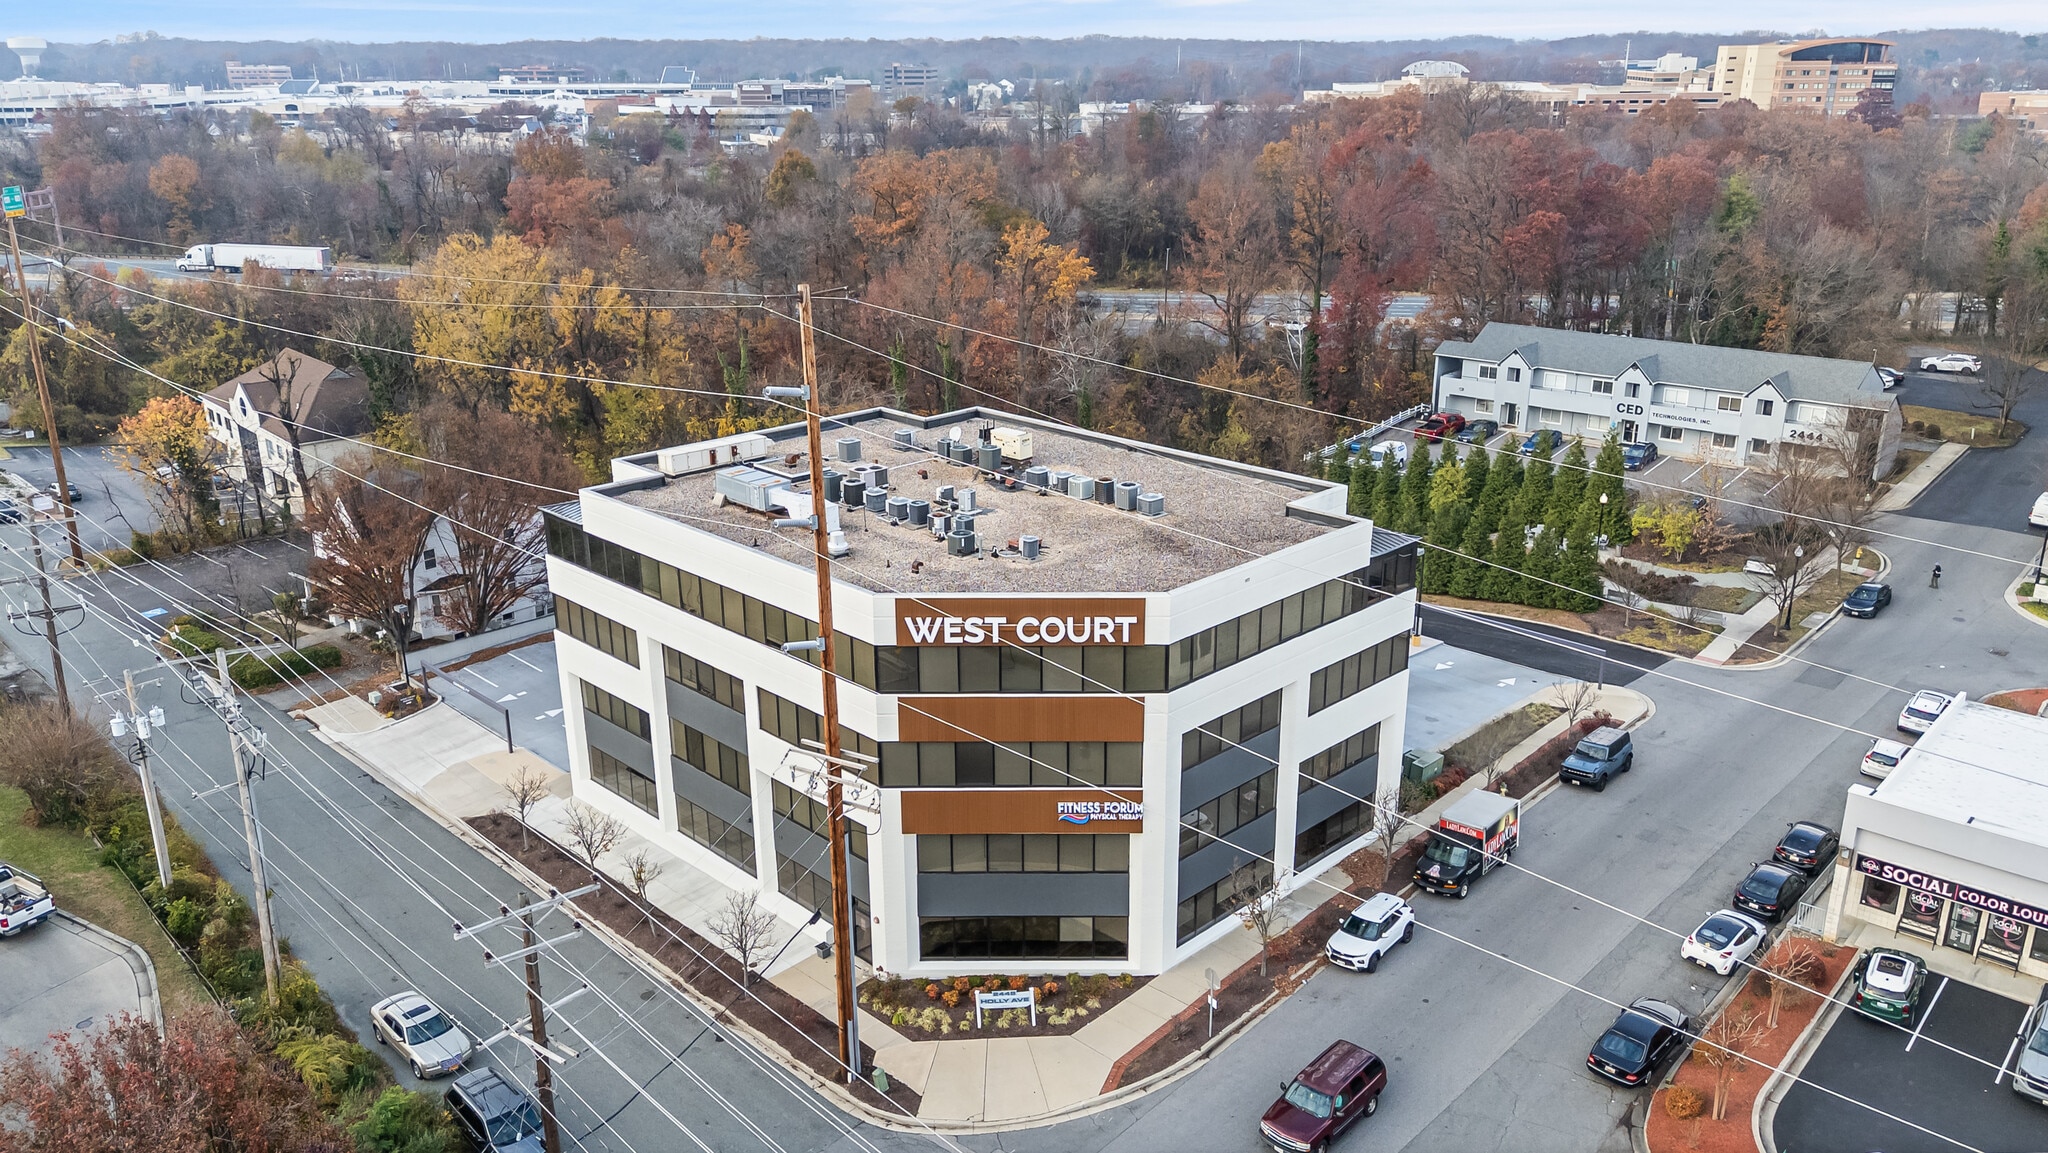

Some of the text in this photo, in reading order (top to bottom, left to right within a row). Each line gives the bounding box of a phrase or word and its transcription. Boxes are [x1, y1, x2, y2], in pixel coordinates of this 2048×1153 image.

[1616, 403, 1644, 416] CED
[1652, 412, 1698, 424] TECHNOLOGIES,
[1789, 429, 1823, 441] 2444
[904, 616, 1138, 644] WEST COURT
[1057, 801, 1144, 814] FITNESS FORUM
[1090, 813, 1143, 821] PHYSICAL THERAPY
[1882, 865, 1953, 898] SOCIAL
[1958, 889, 2009, 913] COLOR
[1911, 893, 1939, 906] SOCIAL
[1993, 918, 2023, 933] SOCIAL
